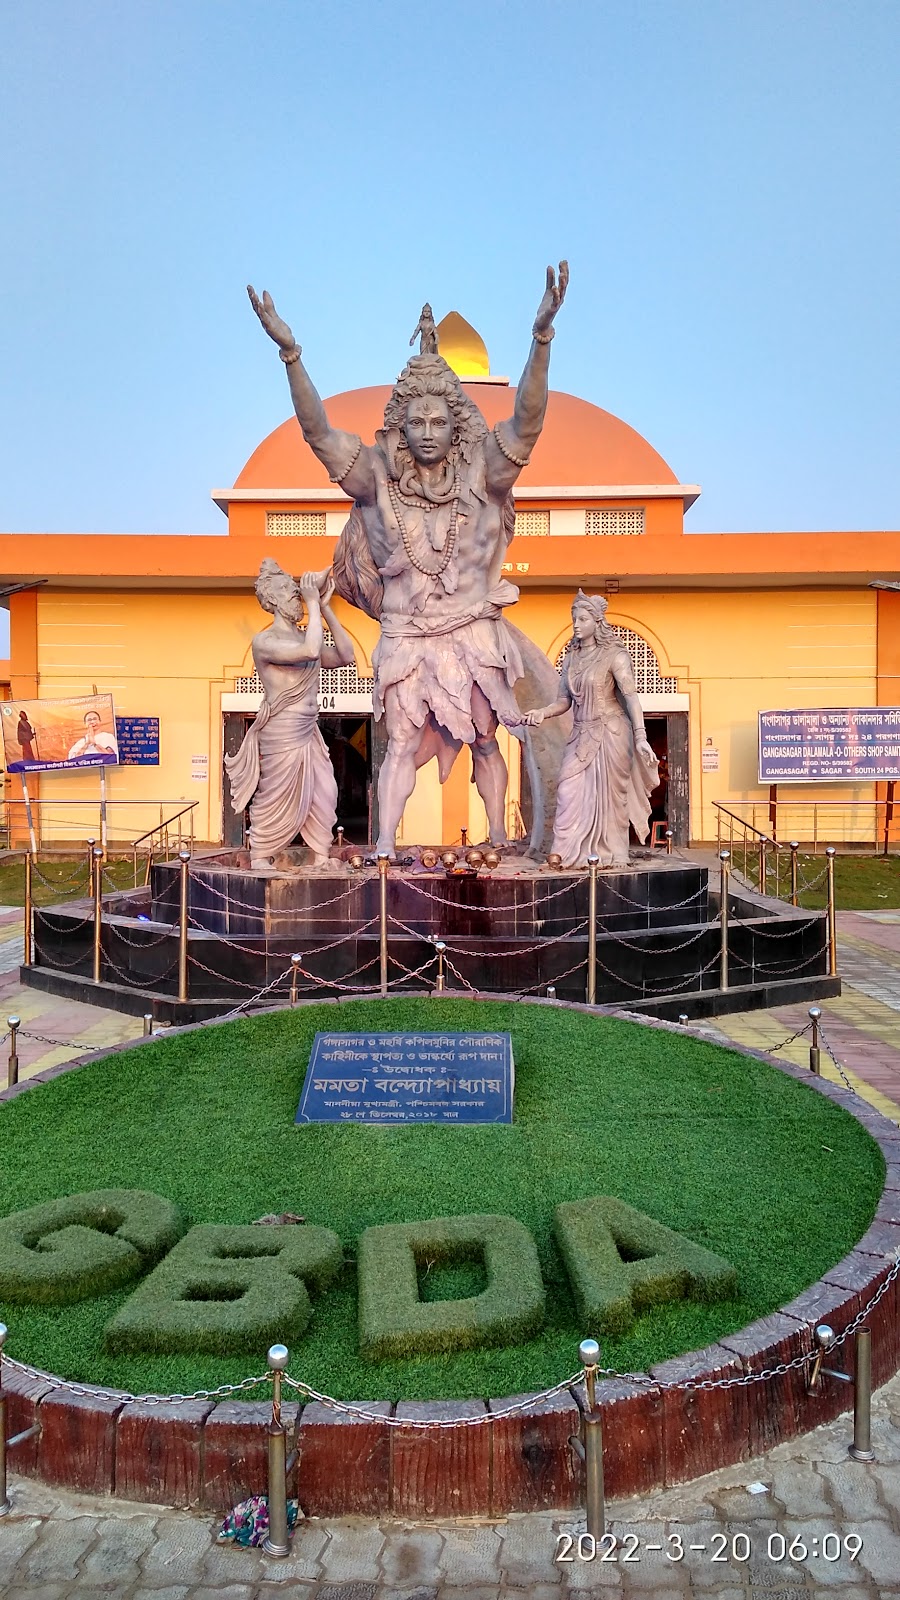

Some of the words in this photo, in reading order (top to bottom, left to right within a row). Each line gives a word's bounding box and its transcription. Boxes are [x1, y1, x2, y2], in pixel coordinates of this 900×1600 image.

[821, 716, 827, 725] ও
[762, 746, 802, 758] GANGASAGAR
[803, 746, 833, 758] DALAMALA
[844, 746, 867, 757] OTHERS
[867, 746, 884, 757] SHOP
[368, 1039, 376, 1047] ও
[405, 1036, 455, 1048] কপিলমুনির
[459, 1036, 503, 1047] পৌরাণিক
[321, 1050, 368, 1061] কাহিনীকে
[406, 1053, 416, 1061] ও
[313, 1077, 370, 1094] মমতা
[373, 1077, 501, 1094] বন্দ্যোপাধ্যায়
